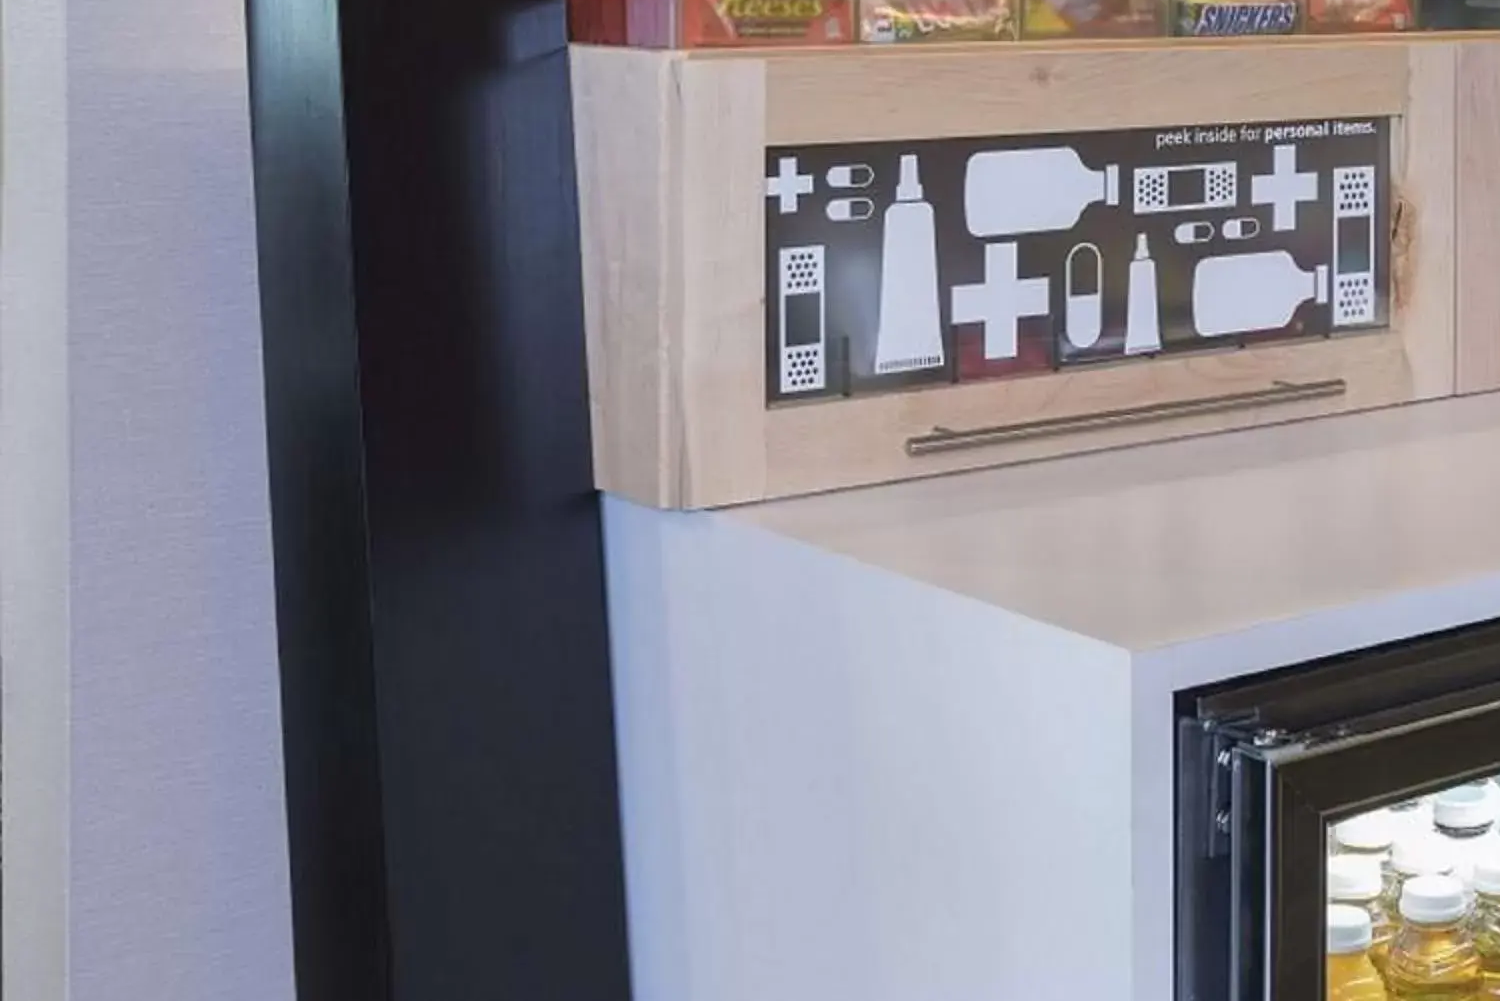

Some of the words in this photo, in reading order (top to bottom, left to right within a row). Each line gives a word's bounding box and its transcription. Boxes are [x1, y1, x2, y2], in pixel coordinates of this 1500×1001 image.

[1155, 128, 1192, 149] peek
[1194, 125, 1237, 146] inside
[1240, 125, 1261, 142] for
[1264, 121, 1329, 144] personal
